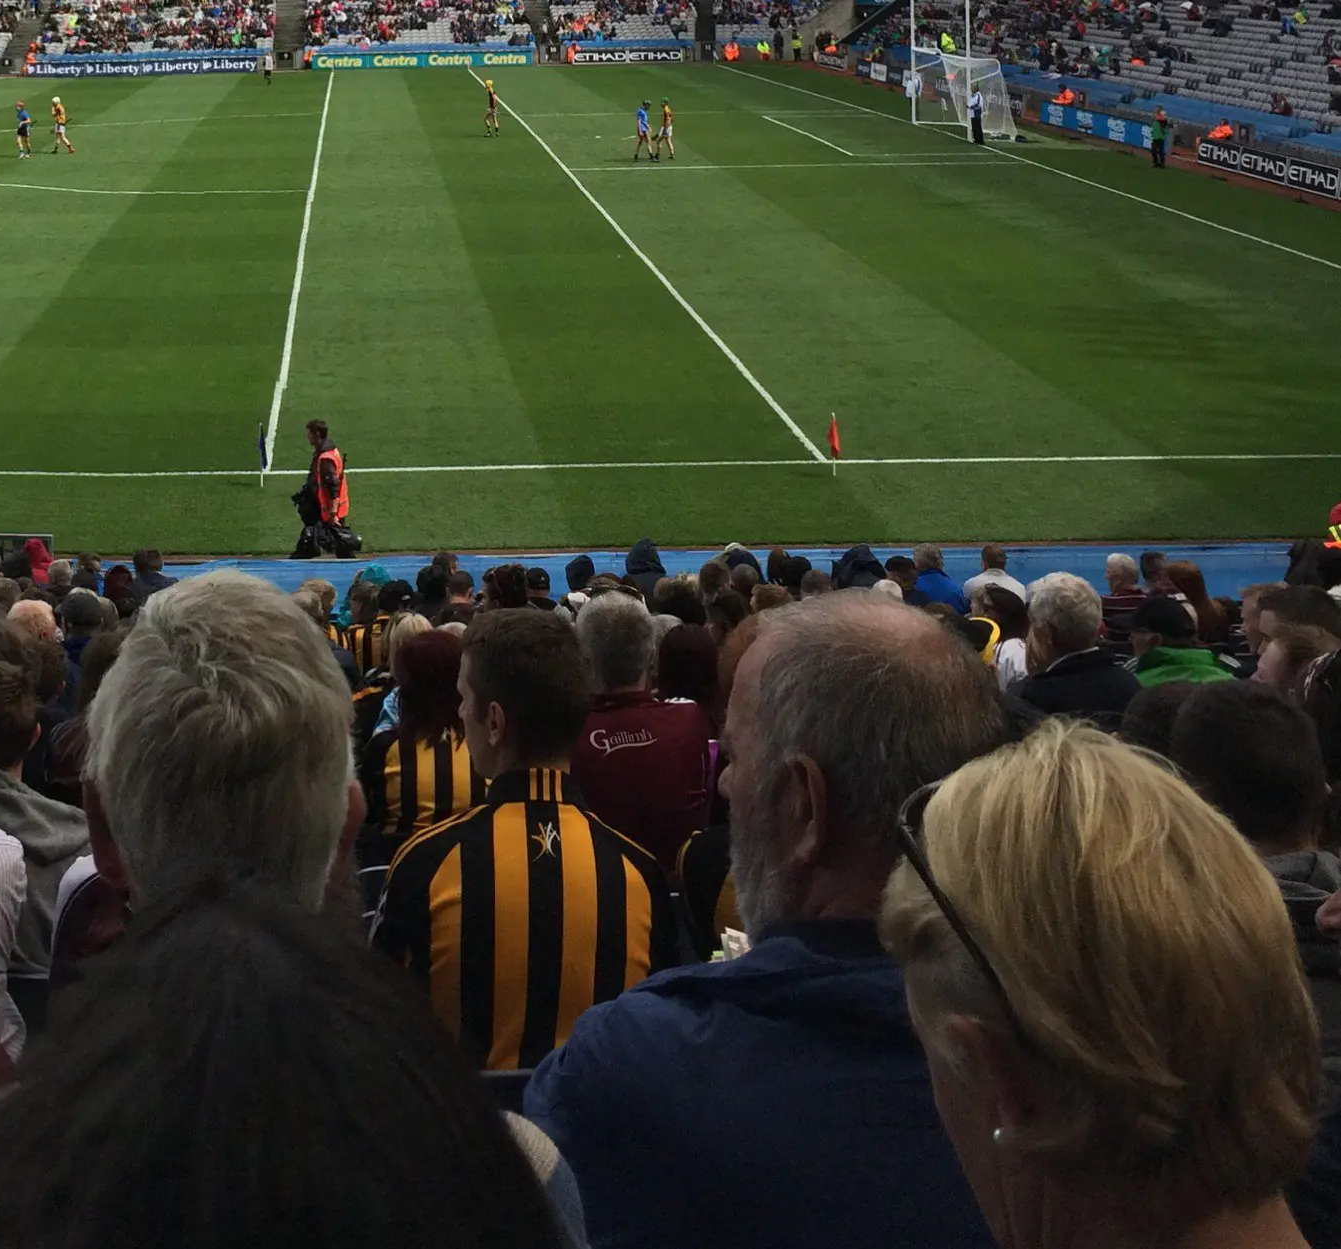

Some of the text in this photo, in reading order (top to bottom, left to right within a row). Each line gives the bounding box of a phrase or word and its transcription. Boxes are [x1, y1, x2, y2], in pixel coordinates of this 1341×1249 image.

[317, 55, 362, 67] Centra
[373, 54, 418, 66] Centra
[428, 54, 472, 66] Centra
[483, 53, 526, 64] Centra
[574, 51, 626, 61] ETIHAD
[629, 50, 681, 60] ETIHAD
[36, 63, 82, 77] Liberty
[95, 63, 140, 76] Liberty
[154, 61, 199, 74] Liberty
[213, 58, 256, 71] Liberty
[1198, 142, 1239, 165] ETIHAD
[1241, 154, 1285, 176] ETIHAD
[1288, 165, 1337, 190] ETIHAD
[590, 728, 657, 757] Gaillimh
